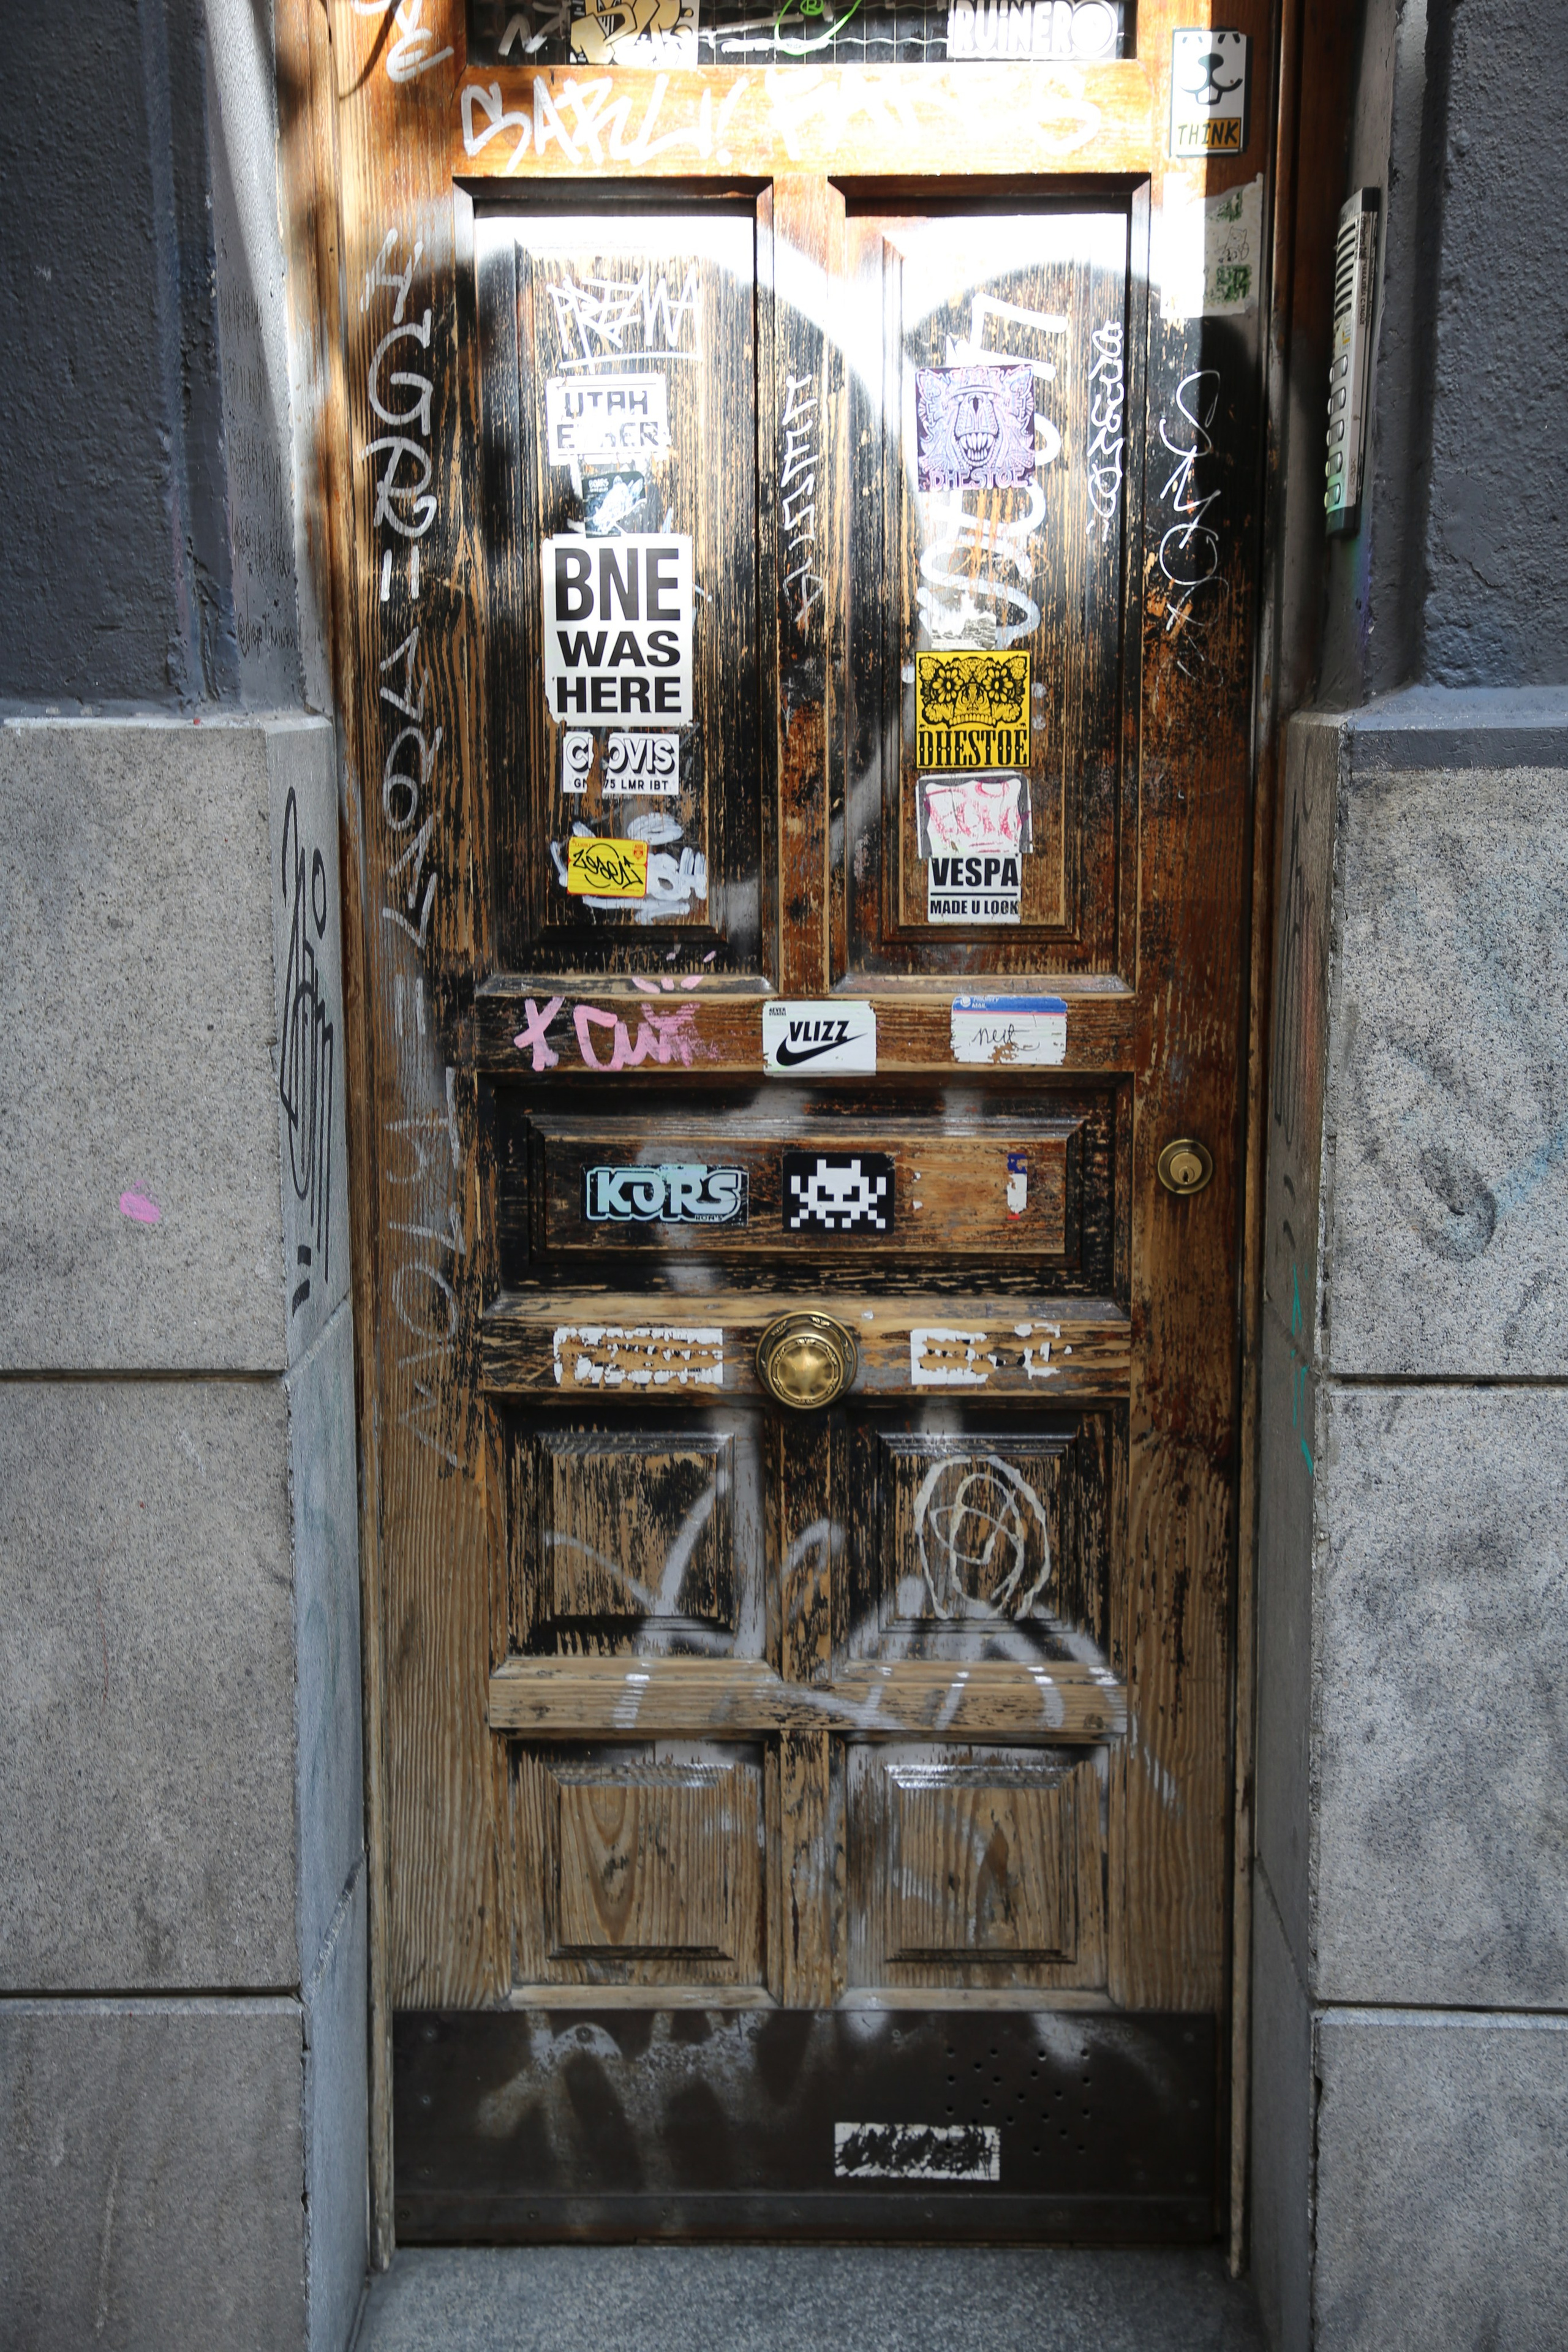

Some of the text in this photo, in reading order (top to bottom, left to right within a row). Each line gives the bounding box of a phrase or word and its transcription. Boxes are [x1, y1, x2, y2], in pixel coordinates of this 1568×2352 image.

[1178, 119, 1239, 146] THINK
[564, 390, 649, 419] UTAH
[556, 421, 660, 449] EER
[929, 467, 1028, 490] DHESTOE
[555, 548, 681, 621] BNE
[557, 630, 681, 668] WAS
[557, 676, 682, 713] HERE
[918, 729, 1028, 767] DHESTOE
[621, 779, 645, 790] LMR
[649, 780, 669, 791] IBT
[931, 857, 1019, 887] VESPA
[930, 900, 1019, 914] MADE U LOOK
[790, 1020, 850, 1042] VLIZZ
[590, 1168, 739, 1219] KORS
